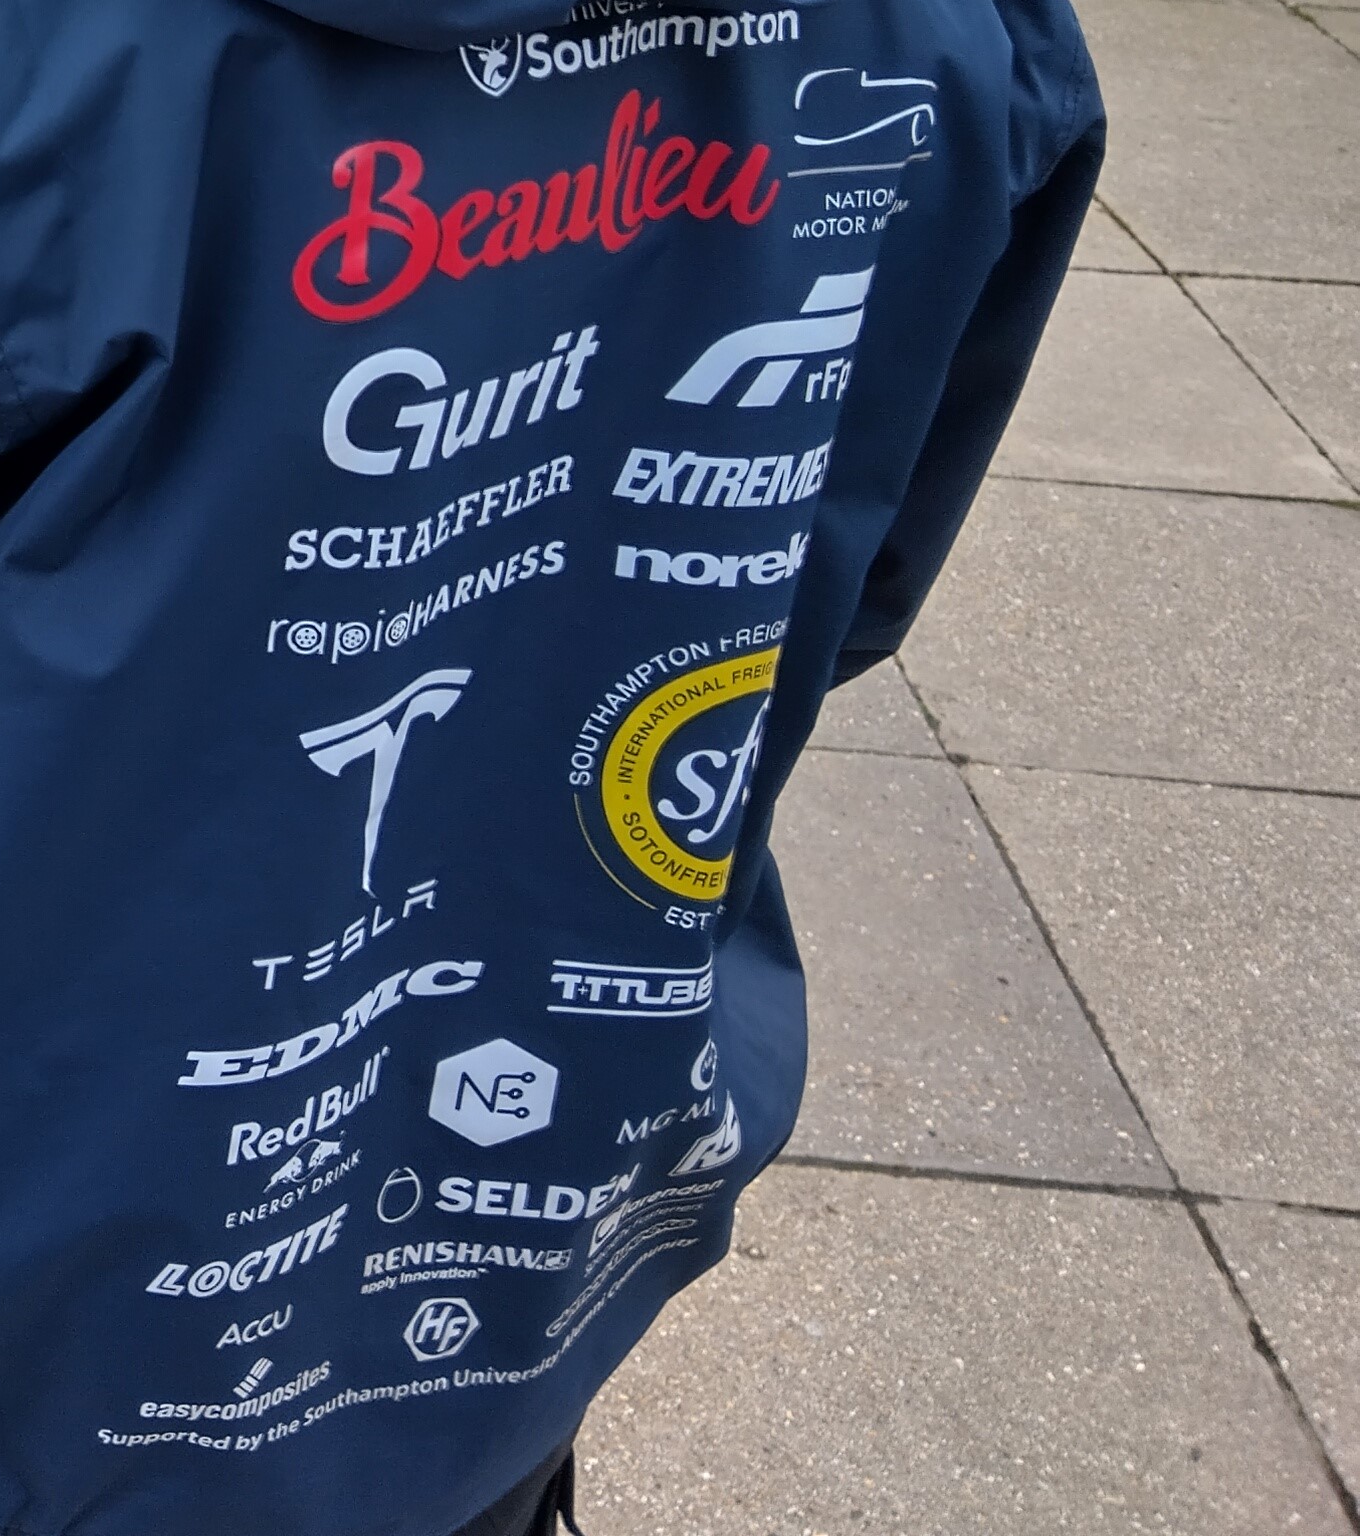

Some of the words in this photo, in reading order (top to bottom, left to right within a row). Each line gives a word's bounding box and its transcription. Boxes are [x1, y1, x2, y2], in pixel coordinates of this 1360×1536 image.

[525, 9, 800, 81] Southampton
[292, 88, 780, 323] Beaulieu
[792, 215, 866, 239] MOTOR
[322, 324, 600, 478] Gurit
[284, 454, 574, 571] SCHAEFFLER
[266, 540, 567, 664] rapidHARNESS
[568, 640, 710, 787] SOUTHAMPTON
[618, 677, 726, 784] INTERNATIONAL
[252, 878, 439, 990] TESLA
[176, 961, 485, 1086] EDMC
[615, 1107, 679, 1145] MG
[224, 1183, 307, 1229] ENERGY
[310, 1148, 363, 1195] DRINK
[146, 1203, 349, 1298] LOCTITE
[360, 1273, 397, 1295] apply
[363, 1240, 545, 1278] RENISHAW
[97, 1426, 231, 1451] Supported
[234, 1433, 265, 1452] by
[266, 1420, 300, 1443] the
[303, 1375, 449, 1425] Southampton
[453, 1348, 561, 1388] University
[138, 1359, 331, 1421] easycomposites
